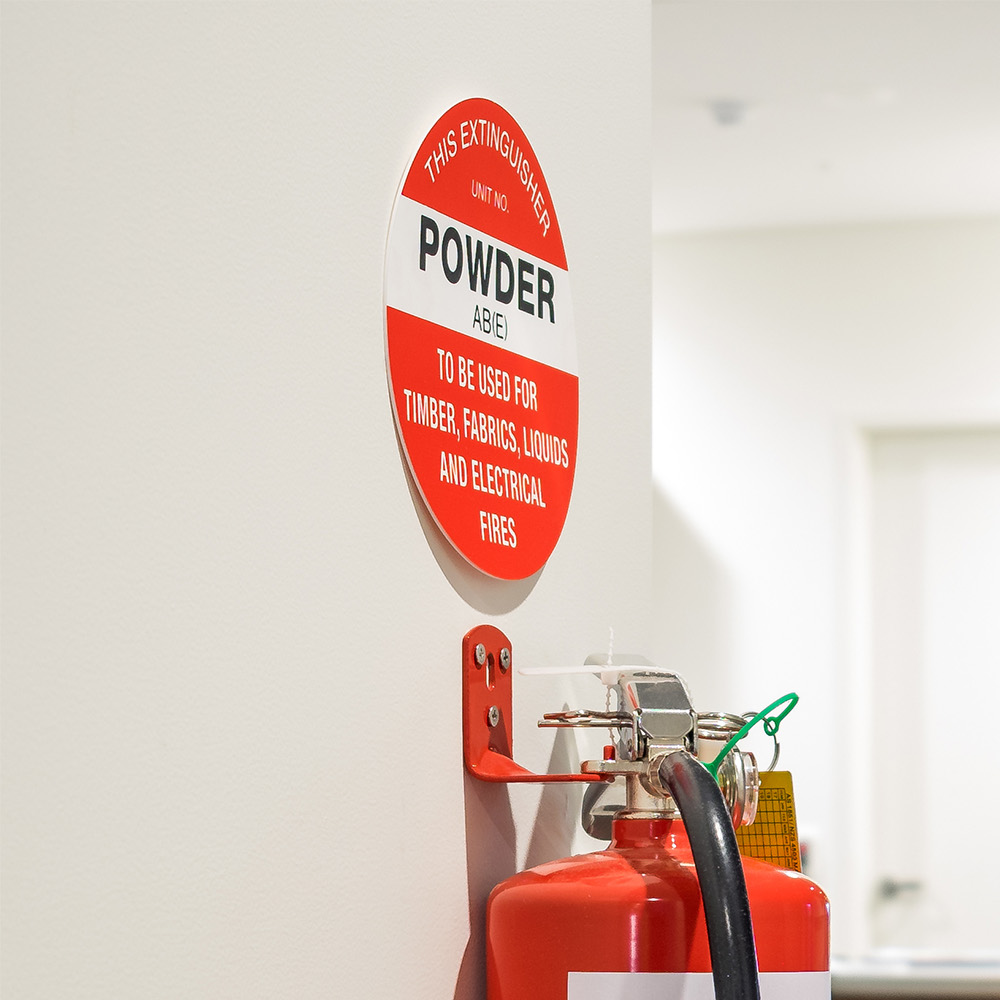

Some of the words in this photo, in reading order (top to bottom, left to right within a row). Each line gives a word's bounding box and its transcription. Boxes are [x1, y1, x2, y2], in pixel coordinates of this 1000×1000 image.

[424, 130, 458, 183] THIS
[460, 118, 551, 237] EXTINGUISHER
[471, 179, 493, 205] UNIT
[494, 193, 510, 213] NO.
[419, 214, 556, 324] POWDER
[472, 304, 508, 341] AB(E)
[437, 348, 454, 384] TO
[458, 355, 475, 391] BE
[478, 363, 511, 402] USED
[514, 375, 538, 412] FOR
[403, 388, 461, 442] TIMBER,
[463, 407, 521, 459] FABRICS,
[523, 426, 569, 469] LIQUIDS
[440, 451, 468, 488] AND
[472, 460, 547, 508] ELECTRICAL
[479, 510, 517, 549] FIRES
